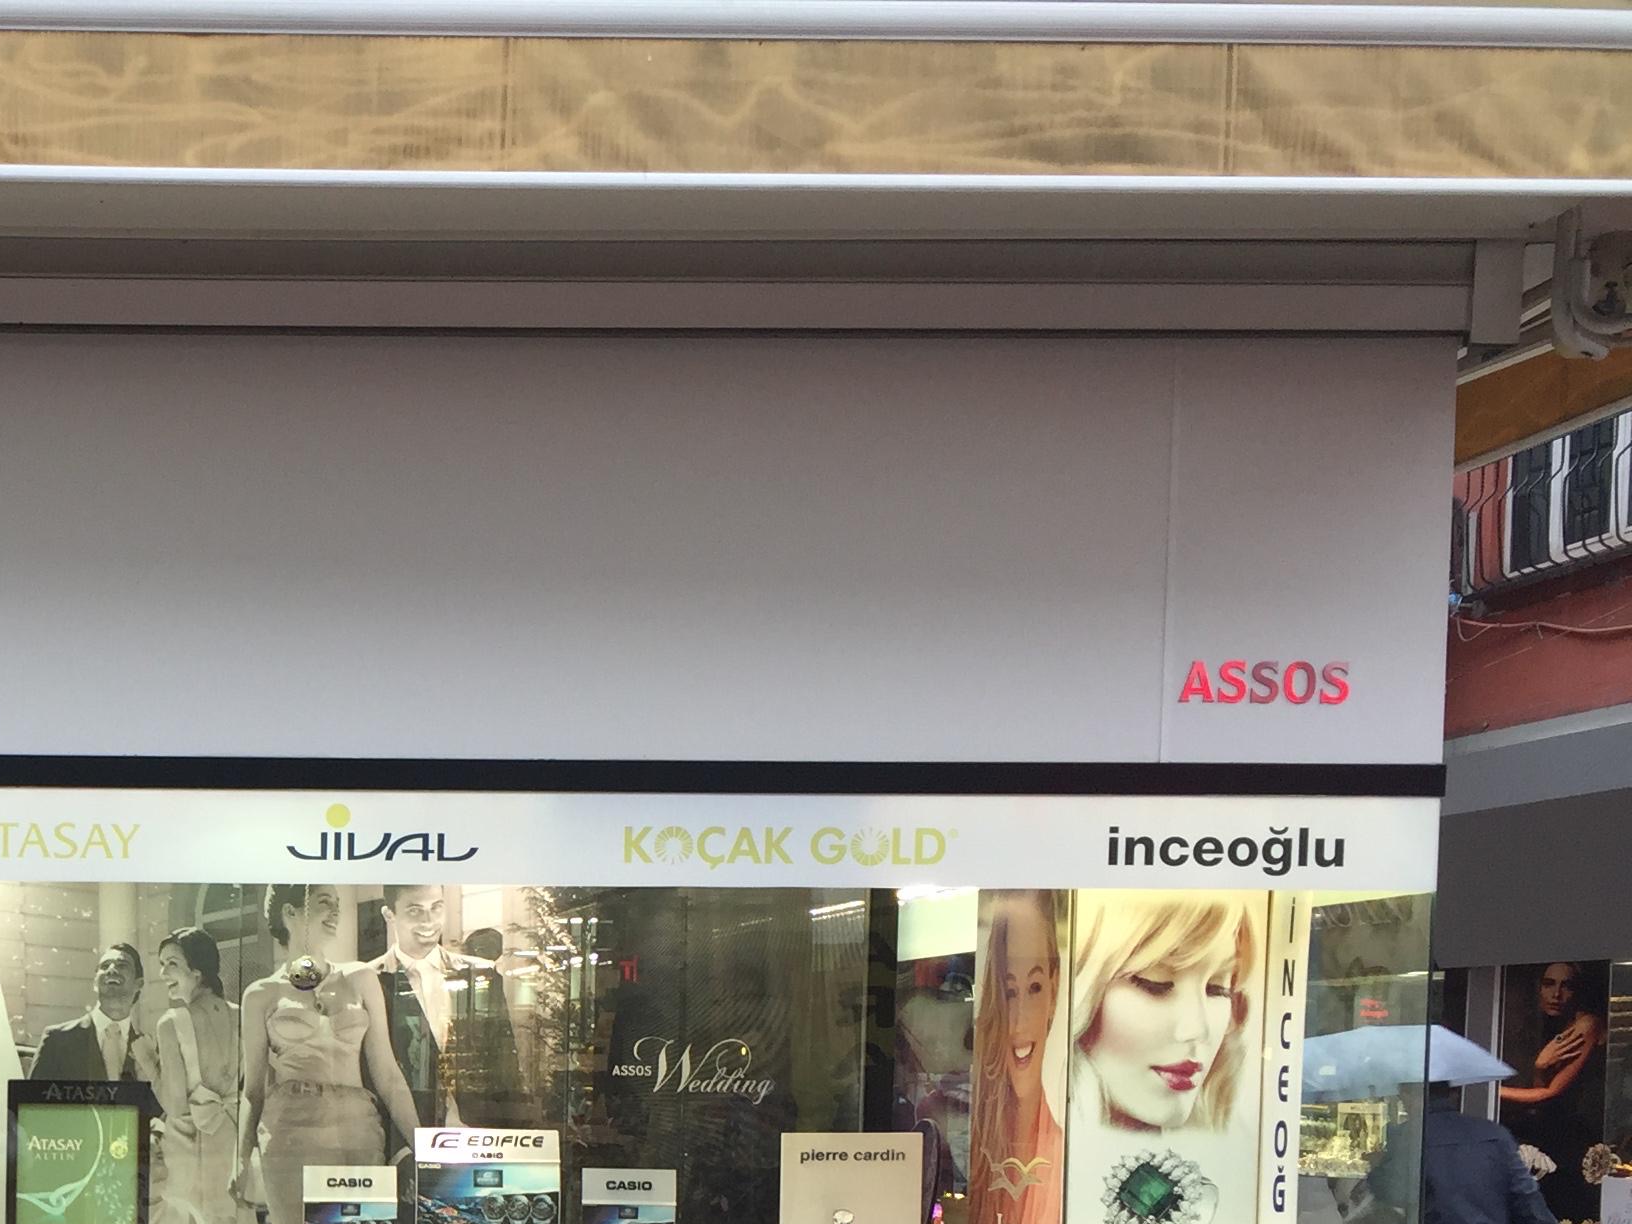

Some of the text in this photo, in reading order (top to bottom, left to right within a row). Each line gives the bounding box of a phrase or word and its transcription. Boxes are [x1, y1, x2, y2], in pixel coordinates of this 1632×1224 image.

[1177, 659, 1351, 705] ASSOS
[623, 826, 947, 870] KOÇAK GOLD
[1108, 826, 1345, 876] inceoğlu
[612, 1036, 775, 1105] ASSOS Wedding
[42, 1083, 117, 1100] ATASAY
[27, 1136, 83, 1150] ATASAY
[468, 1135, 544, 1148] EDIFICE
[35, 1152, 75, 1160] ALTIN
[800, 1149, 906, 1164] pierre cardin
[327, 1177, 373, 1188] CASIO
[606, 1180, 652, 1191] CASIO
